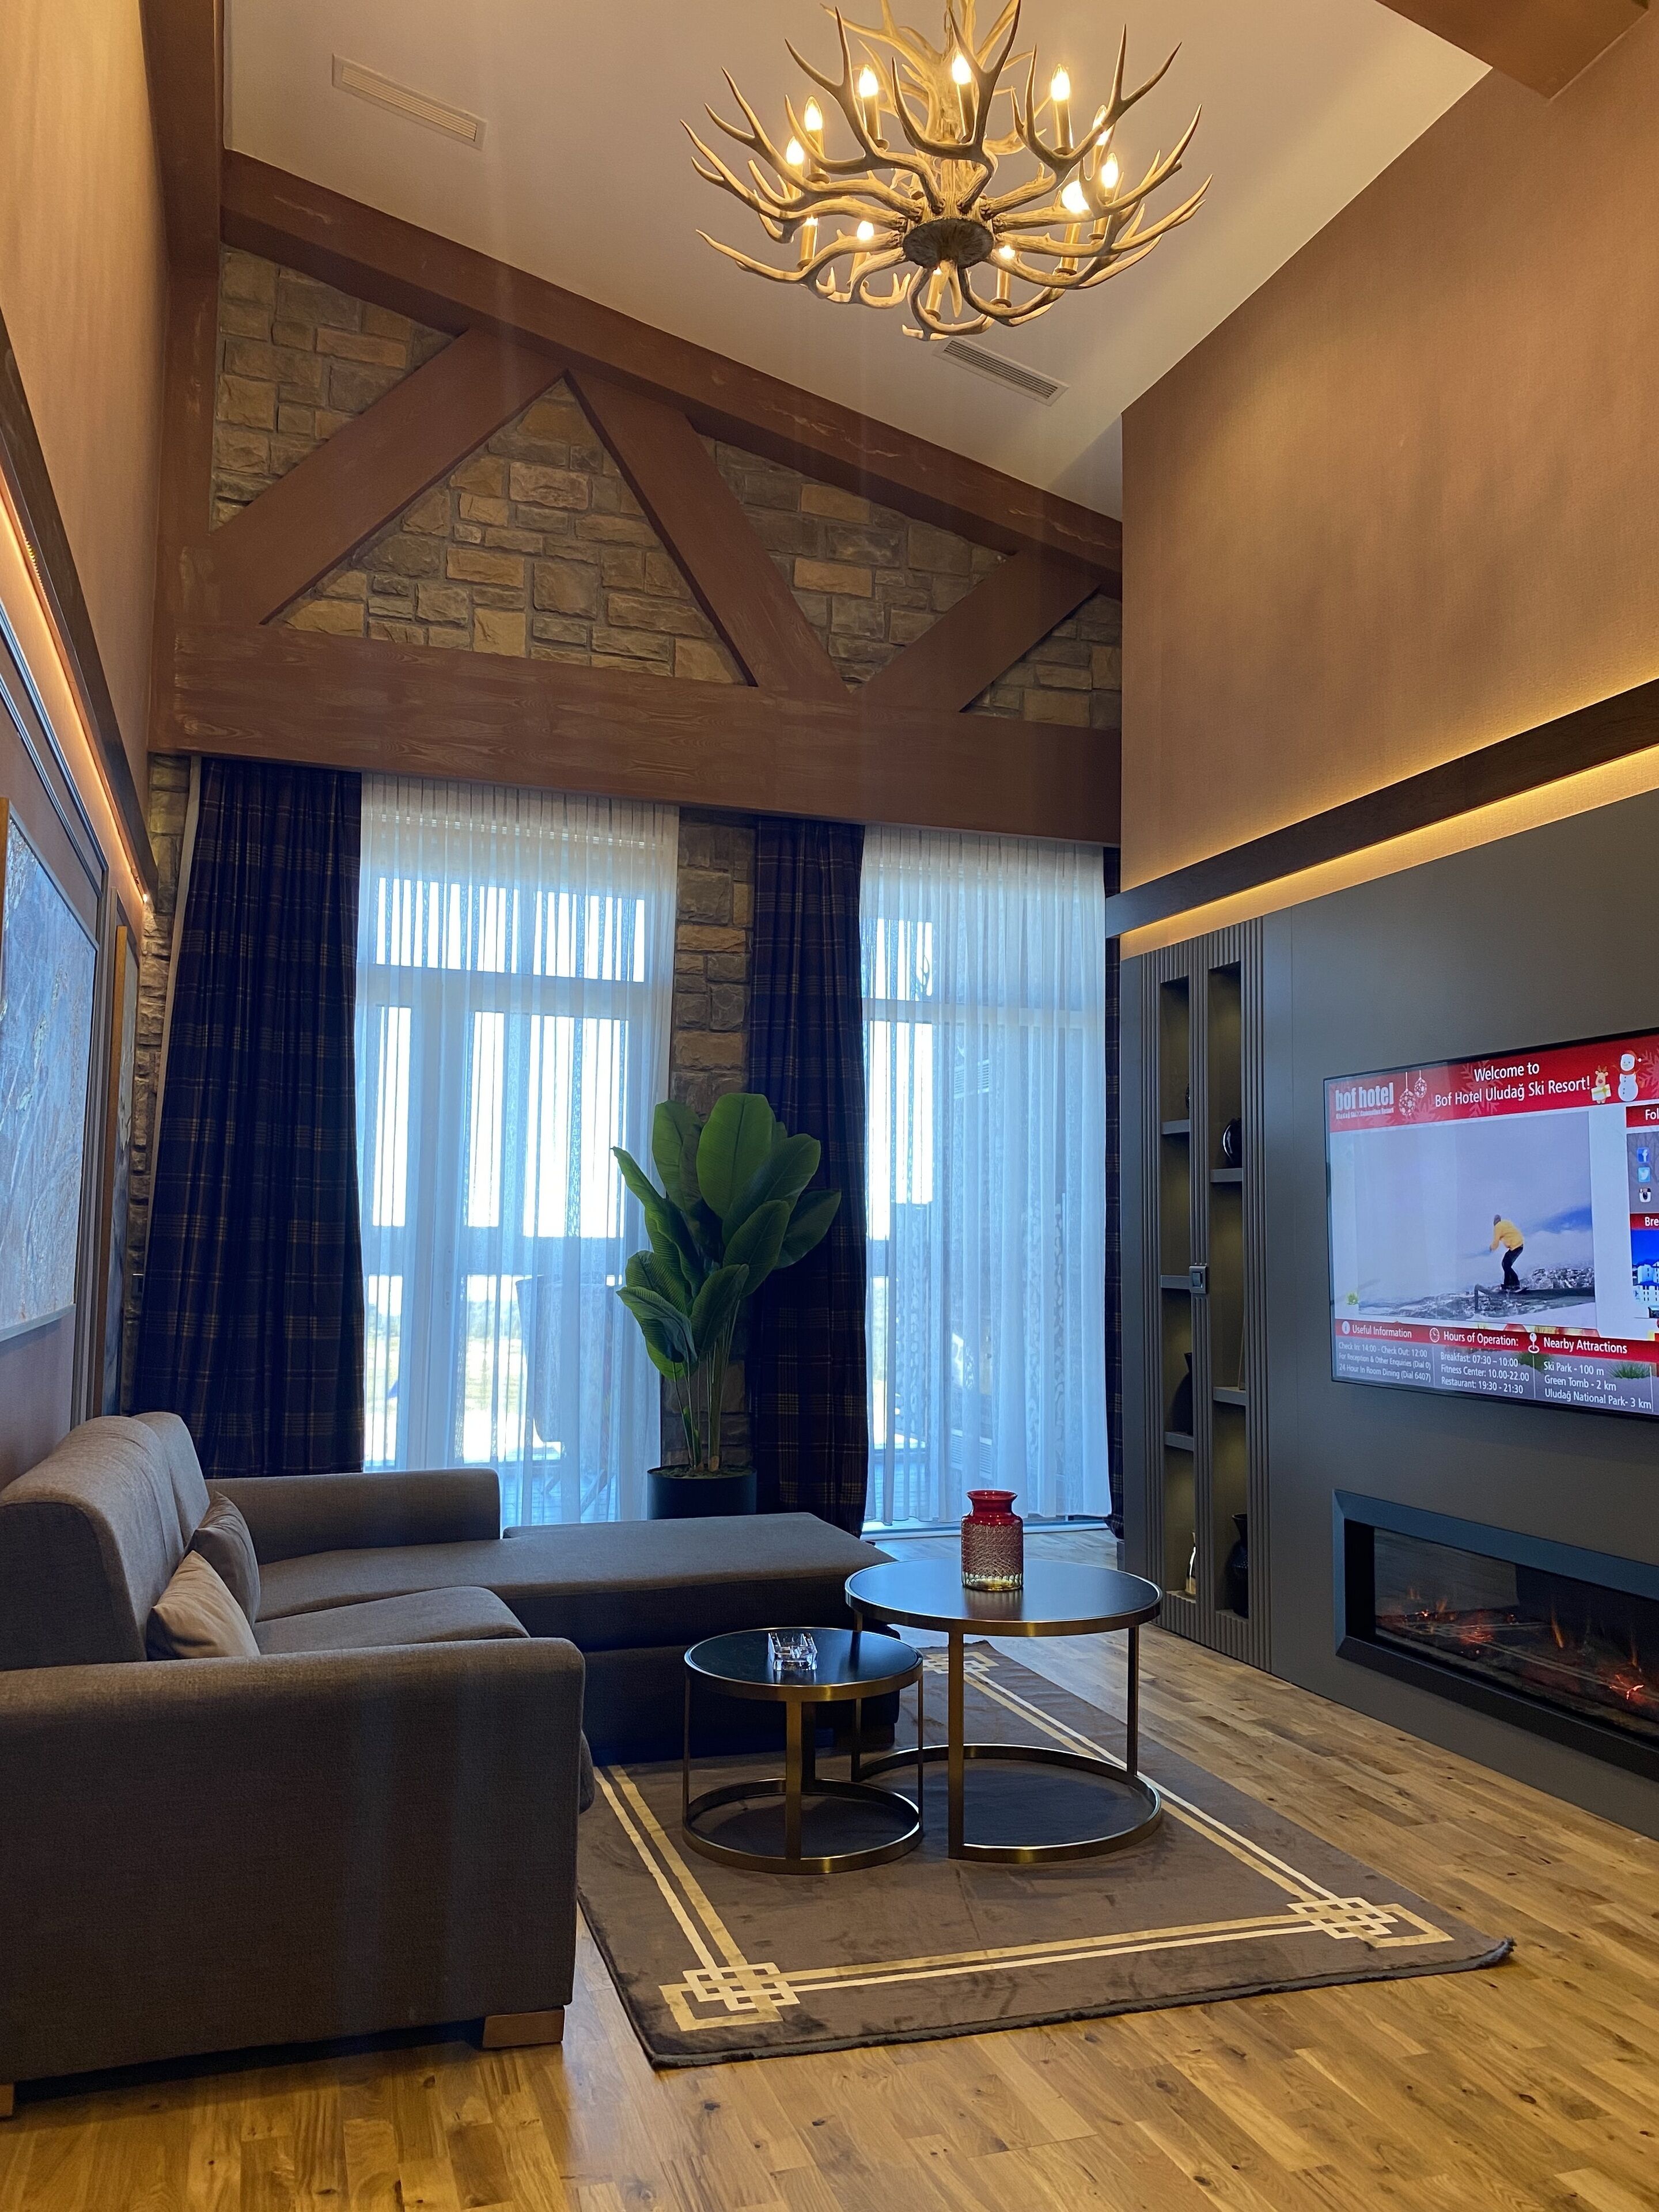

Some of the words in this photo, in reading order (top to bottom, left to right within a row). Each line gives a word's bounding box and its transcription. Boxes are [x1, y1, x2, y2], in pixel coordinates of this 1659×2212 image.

[1474, 1066, 1524, 1082] Welcome
[1527, 1062, 1539, 1074] to
[1335, 1087, 1357, 1111] bof
[1359, 1082, 1394, 1108] hotel
[1435, 1092, 1452, 1107] Bof
[1455, 1088, 1482, 1105] Hotel
[1486, 1082, 1525, 1101] Uludağ
[1528, 1081, 1544, 1097] Ski
[1548, 1075, 1590, 1094] Resort!
[1645, 1108, 1659, 1120] Fol
[1645, 1216, 1659, 1226] Bre
[1352, 1324, 1372, 1334] Useful
[1373, 1326, 1412, 1338] Information
[1444, 1331, 1465, 1342] Hours
[1467, 1332, 1475, 1343] of
[1477, 1333, 1518, 1346] Operation:
[1339, 1342, 1353, 1350] Check
[1362, 1344, 1376, 1353] 14:00
[1381, 1346, 1397, 1355] Check
[1412, 1349, 1427, 1358] 12:00
[1544, 1336, 1574, 1353] Nearby
[1577, 1339, 1628, 1354] Attractions
[1441, 1352, 1471, 1363] Breakfast:
[1472, 1354, 1491, 1365] 07:30
[1499, 1357, 1518, 1367] 10:00
[1347, 1365, 1359, 1373] Hour
[1366, 1367, 1381, 1376] Room
[1382, 1368, 1400, 1379] Dining
[1401, 1371, 1413, 1380] (Dial
[1415, 1373, 1431, 1382] 6407)
[1441, 1364, 1461, 1374] Fitness
[1463, 1366, 1486, 1377] Center:
[1544, 1361, 1554, 1371] Ski
[1556, 1362, 1572, 1373] Park
[1580, 1365, 1594, 1375] 100
[1441, 1377, 1476, 1389] Restaurant:
[1479, 1381, 1497, 1391] 19:30
[1503, 1383, 1524, 1394] 21:30
[1544, 1374, 1566, 1386] Green
[1568, 1377, 1589, 1388] Tomb
[1596, 1380, 1601, 1389] 2
[1604, 1380, 1616, 1391] km
[1545, 1388, 1571, 1402] Uludağ
[1573, 1391, 1606, 1403] National
[1608, 1395, 1628, 1406] Park-
[1630, 1397, 1636, 1407] 3
[1638, 1398, 1652, 1409] km
